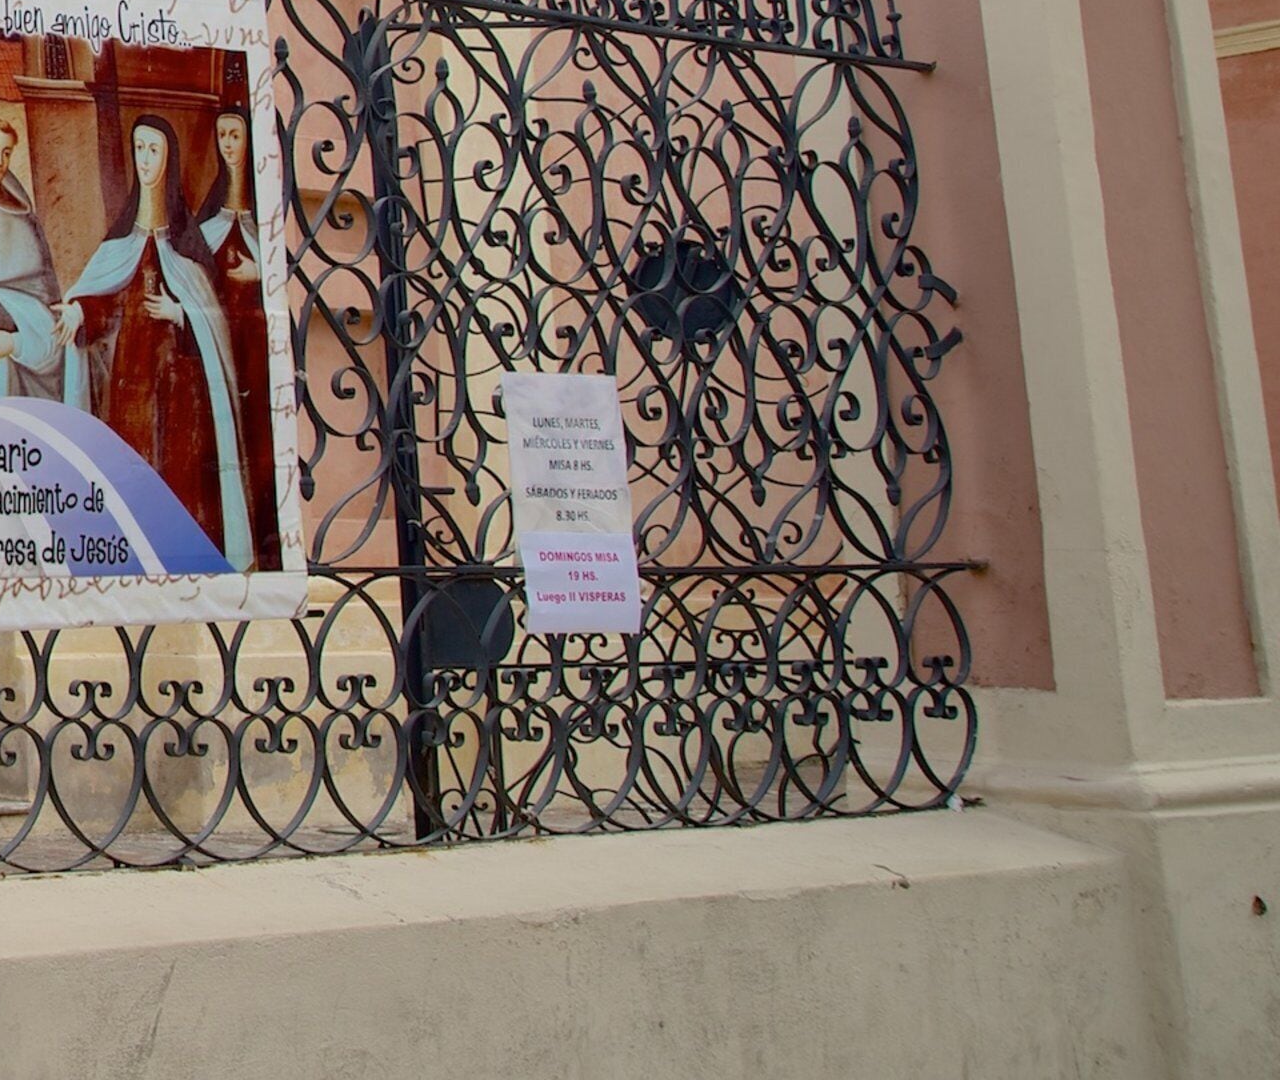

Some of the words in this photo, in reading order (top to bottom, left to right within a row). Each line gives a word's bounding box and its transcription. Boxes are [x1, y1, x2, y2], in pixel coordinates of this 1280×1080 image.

[50, 7, 112, 50] amigo
[532, 417, 564, 429] LUNES,
[565, 418, 600, 431] MARTES,
[522, 435, 572, 449] MIÉRCOLES
[573, 439, 579, 449] Y
[581, 439, 615, 451] VIERNES
[549, 460, 571, 470] MISA
[573, 460, 578, 471] 8
[581, 461, 594, 471] HS.
[84, 482, 104, 513] de
[525, 484, 568, 499] SÁBADOS
[570, 488, 575, 499] Y
[577, 488, 617, 500] FERIADOS
[556, 510, 575, 521] 8.30
[42, 530, 65, 564] de
[71, 533, 129, 564] Jesús
[539, 551, 593, 562] DOMINGOS
[595, 552, 619, 562] MISA
[568, 571, 579, 580] 19
[582, 571, 598, 580] HS.
[537, 592, 566, 603] Luego
[578, 591, 626, 602] VISPERAS
